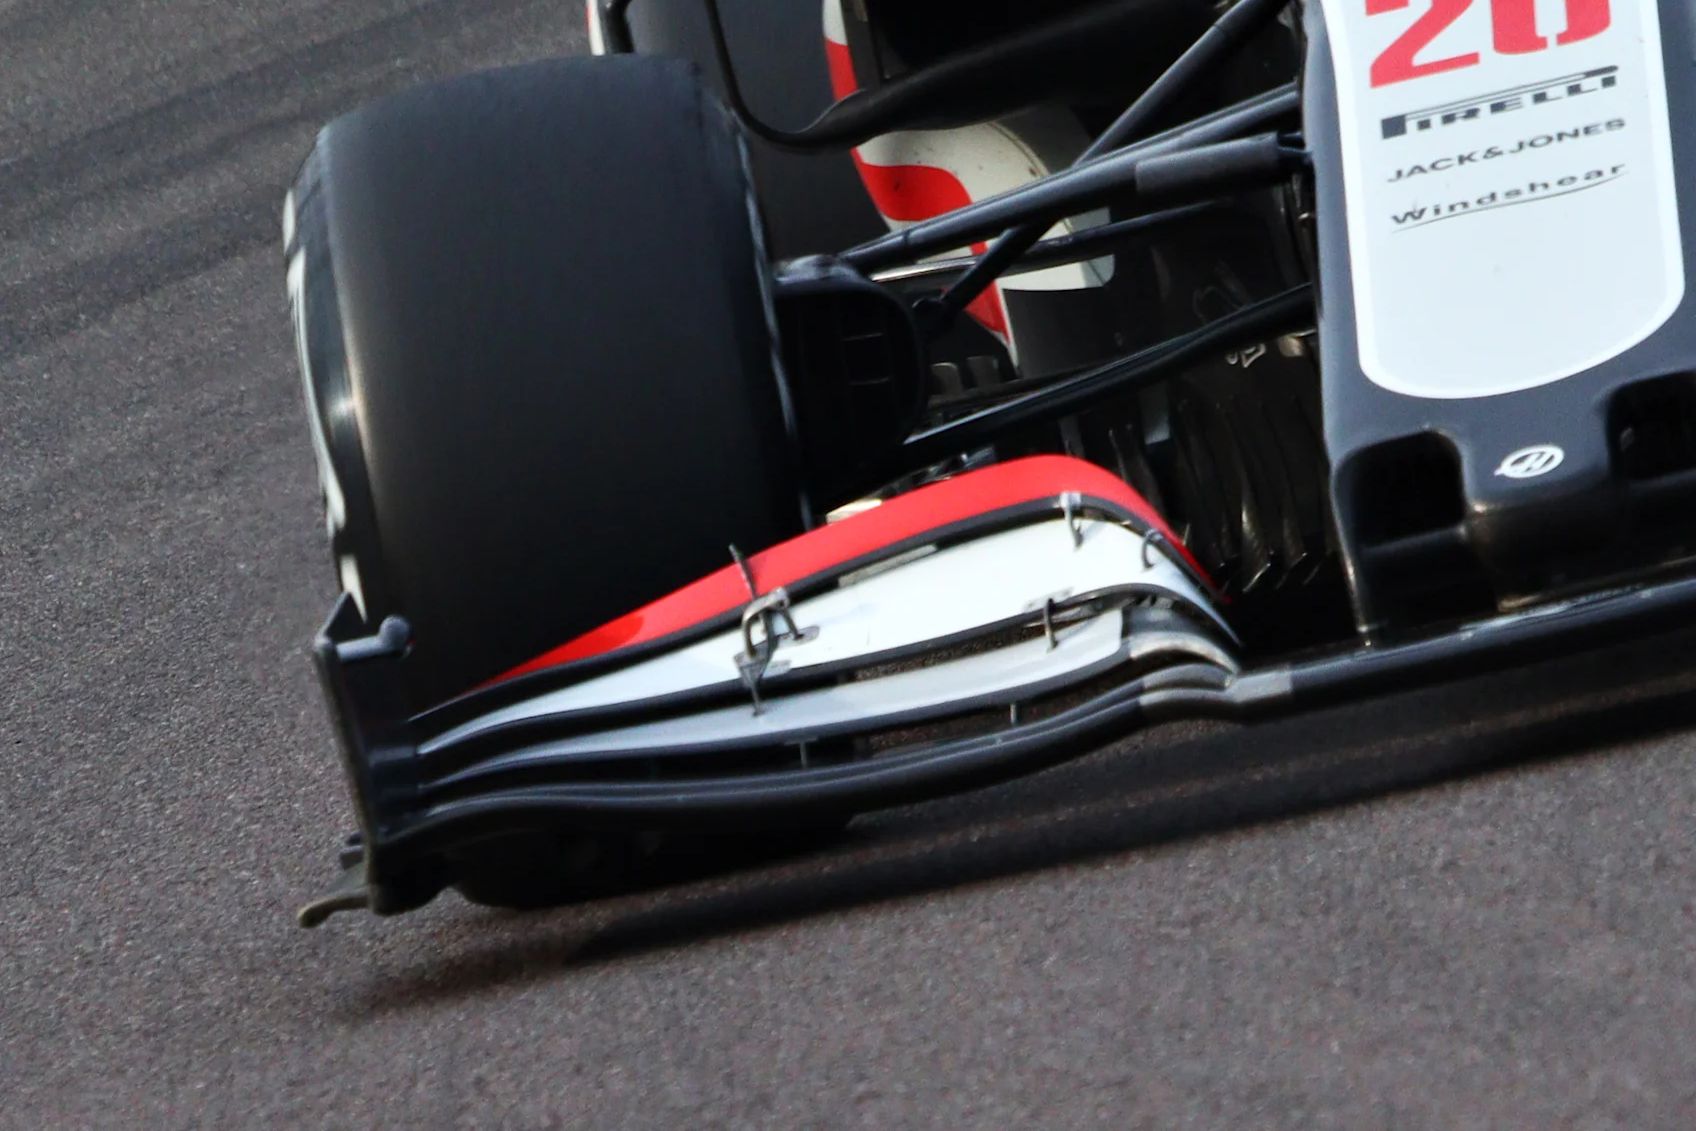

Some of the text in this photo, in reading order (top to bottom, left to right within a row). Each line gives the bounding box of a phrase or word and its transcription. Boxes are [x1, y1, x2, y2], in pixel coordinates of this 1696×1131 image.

[1380, 65, 1619, 141] PIRELLI
[1386, 117, 1627, 183] JACK&JONES
[1391, 164, 1626, 226] Windshear
